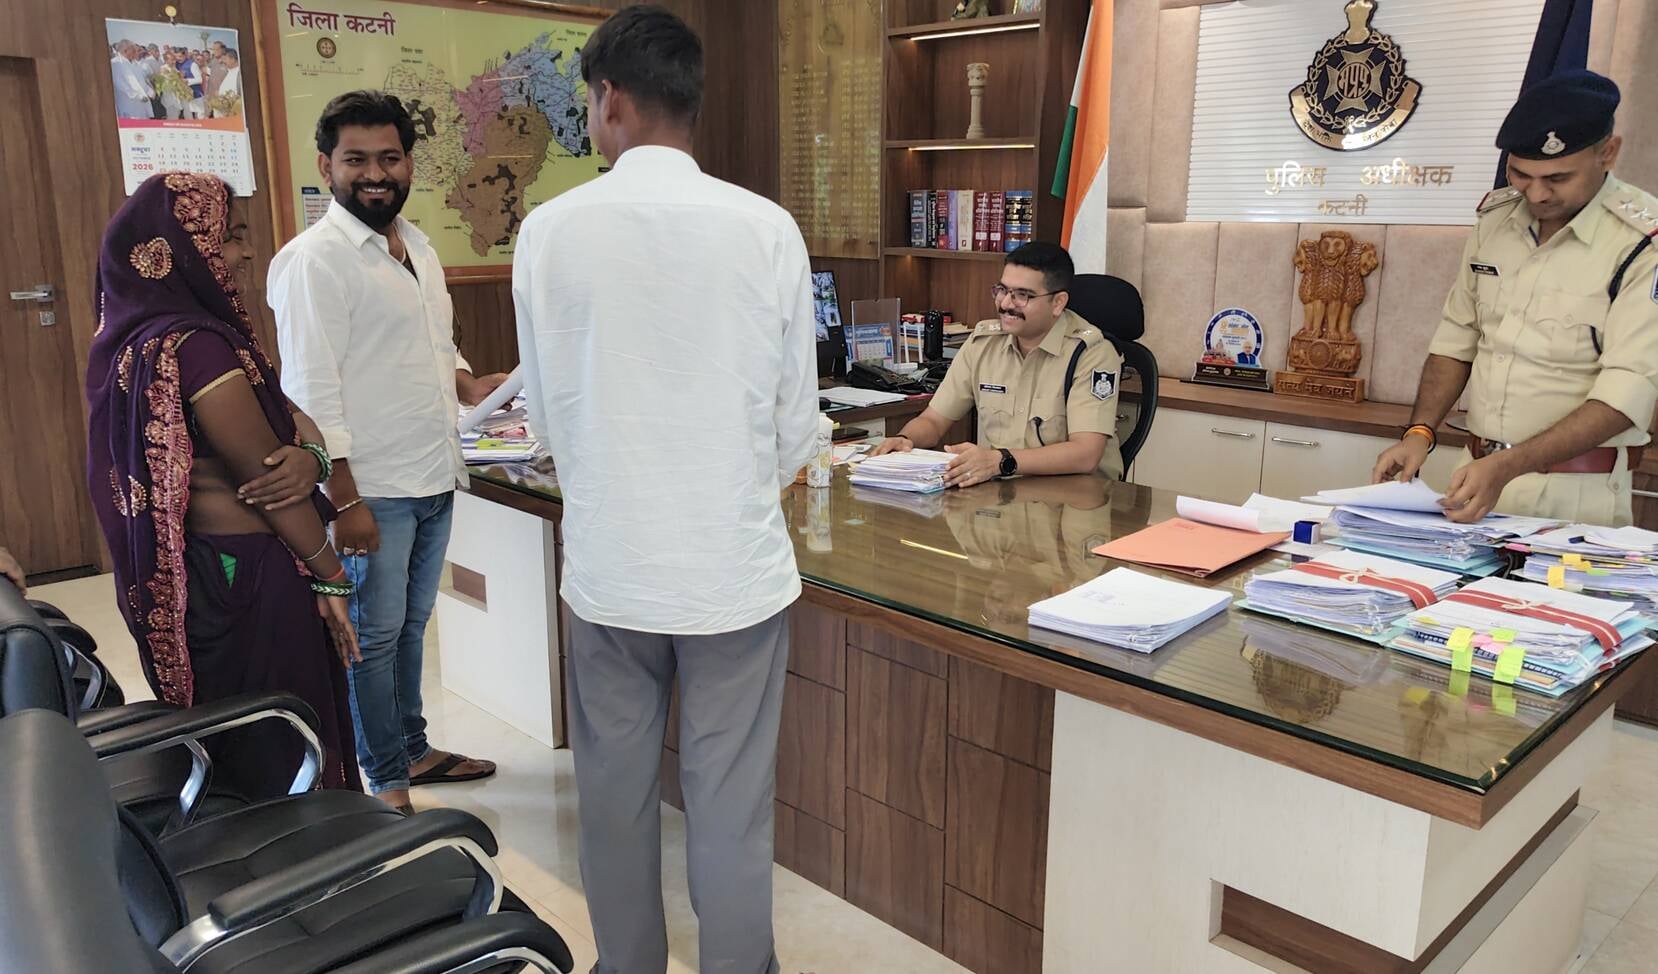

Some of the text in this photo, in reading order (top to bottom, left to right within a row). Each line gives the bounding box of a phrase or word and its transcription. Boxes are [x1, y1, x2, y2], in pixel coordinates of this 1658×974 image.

[286, 2, 396, 36] जिला कटनी
[132, 163, 154, 171] 2026
[1264, 157, 1454, 196] पुलिस अधीक्षक
[1317, 194, 1369, 216] कटनी
